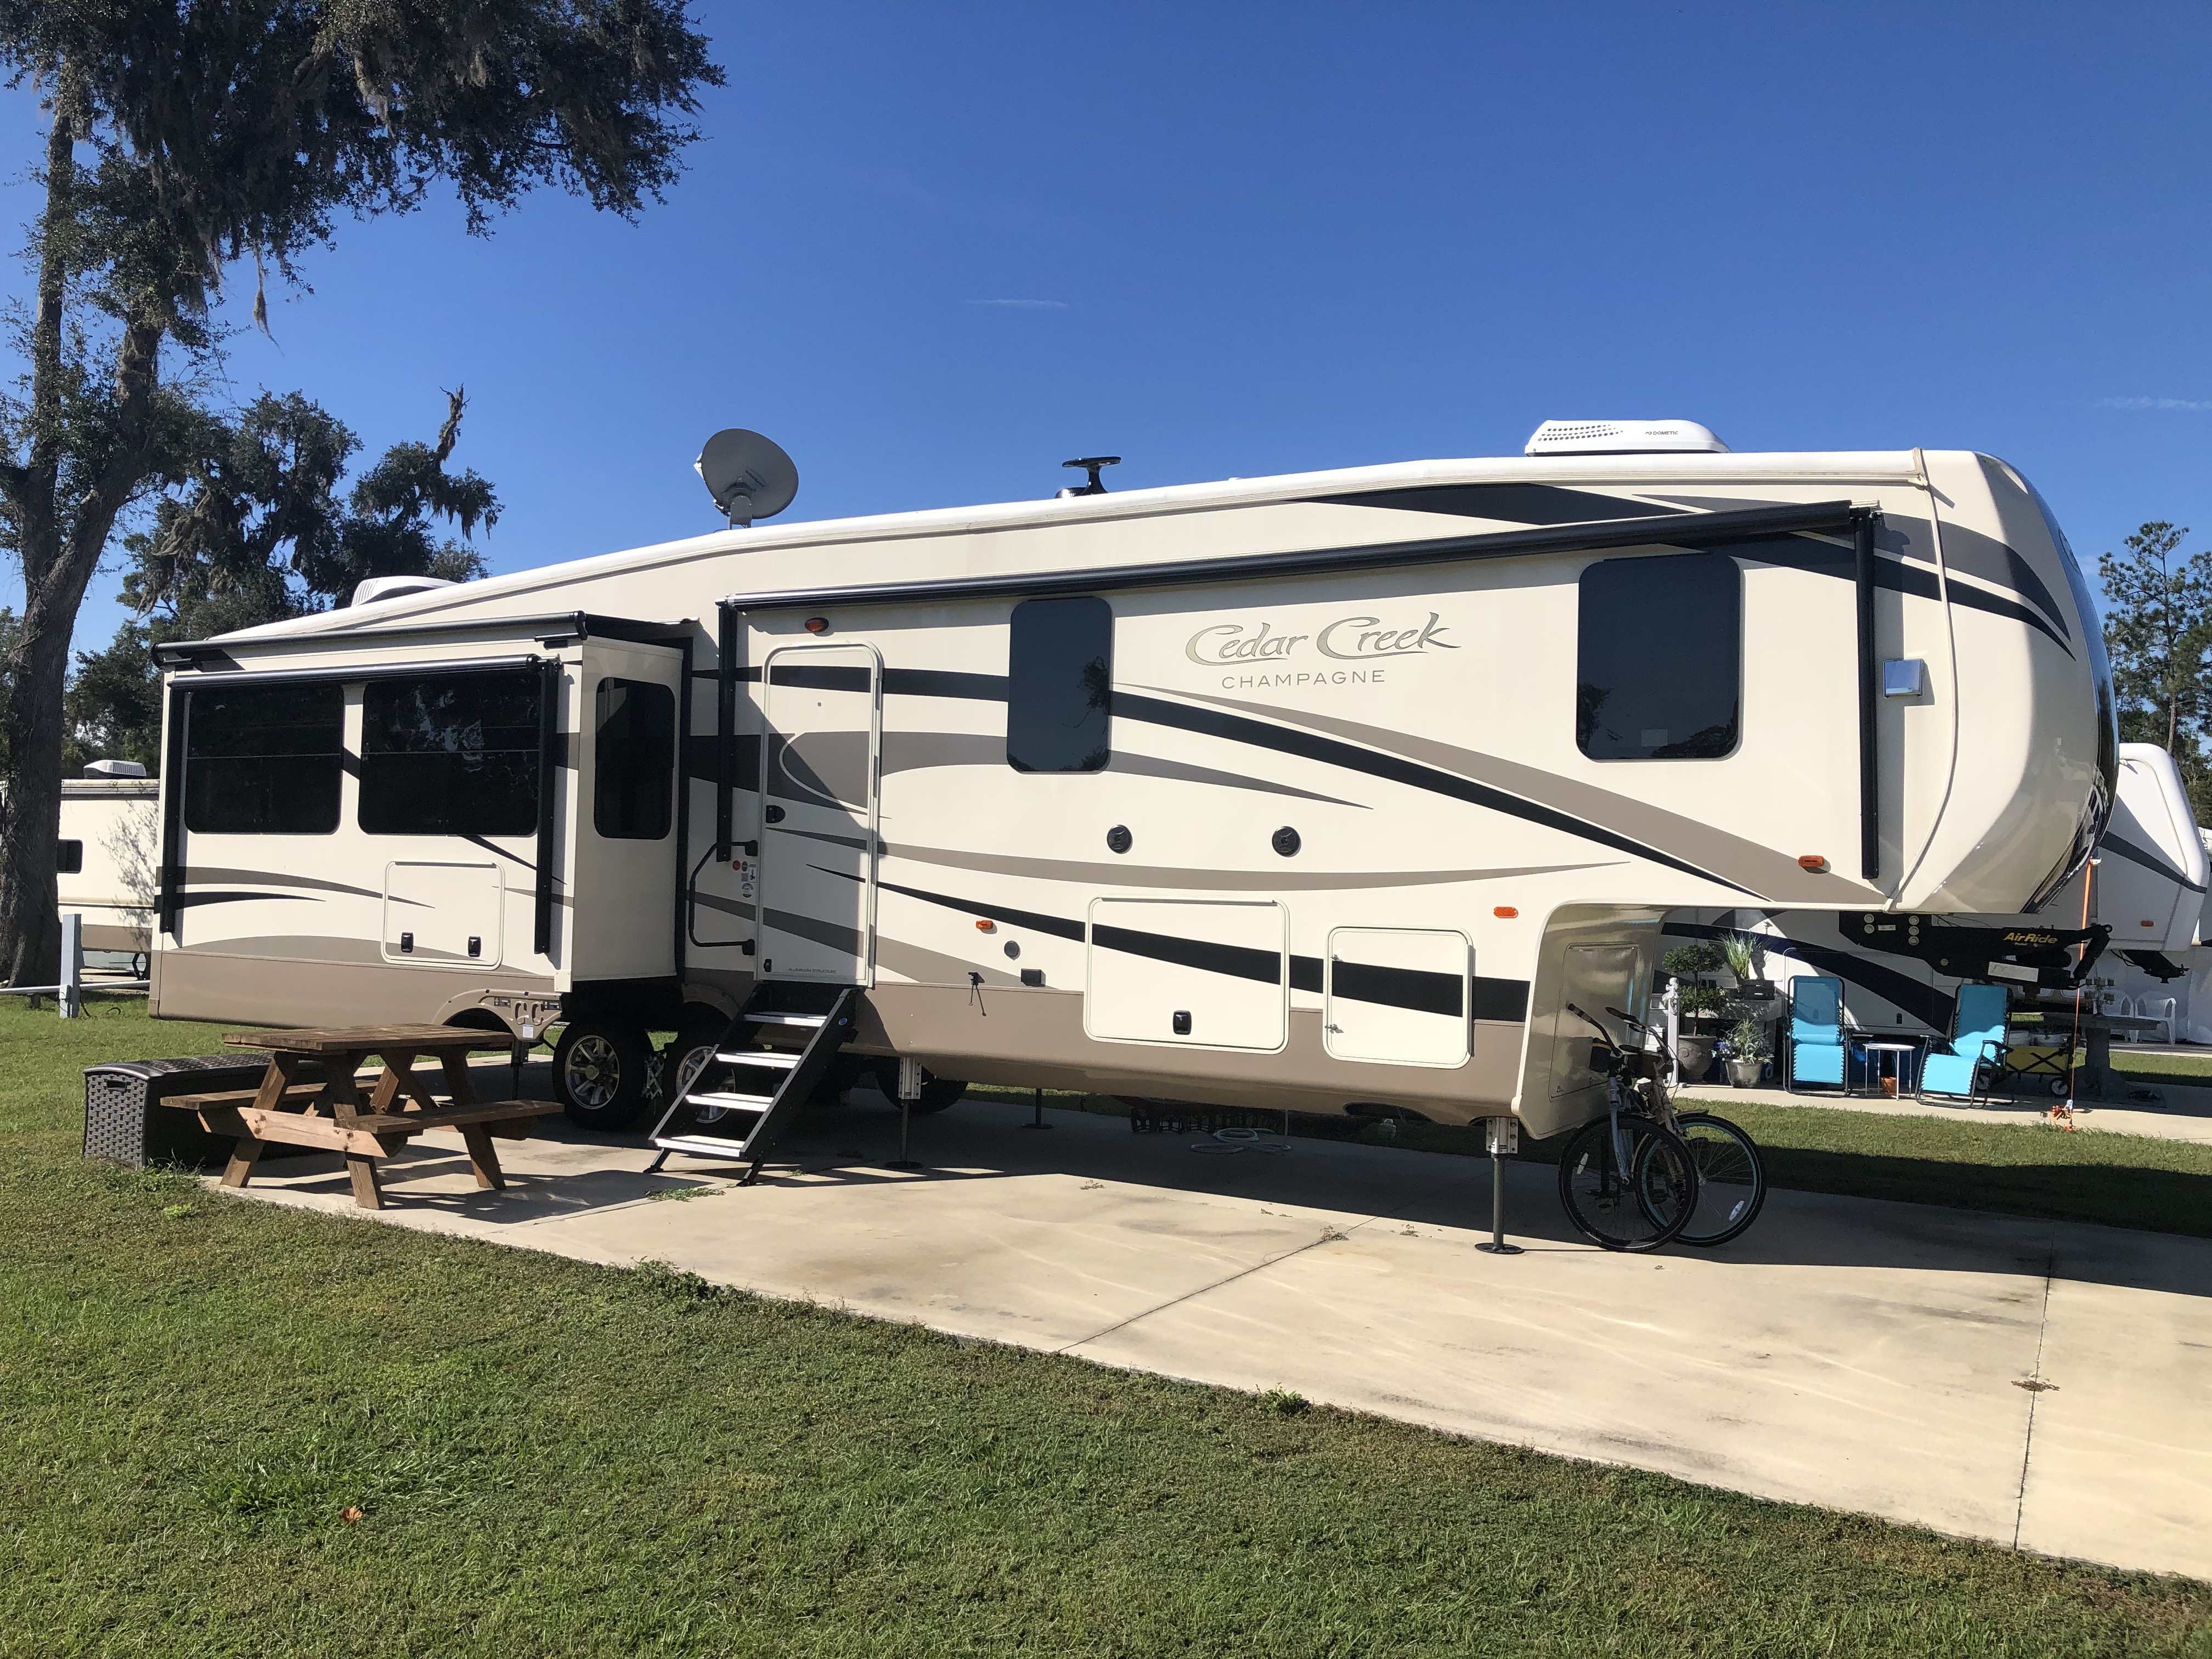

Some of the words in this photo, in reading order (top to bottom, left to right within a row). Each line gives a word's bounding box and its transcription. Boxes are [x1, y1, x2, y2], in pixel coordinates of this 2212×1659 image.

[1185, 622, 1309, 666] Cedar
[1316, 612, 1462, 660] Creek
[1221, 670, 1385, 689] CHAMPAGNE
[2002, 932, 2058, 944] AirRide
